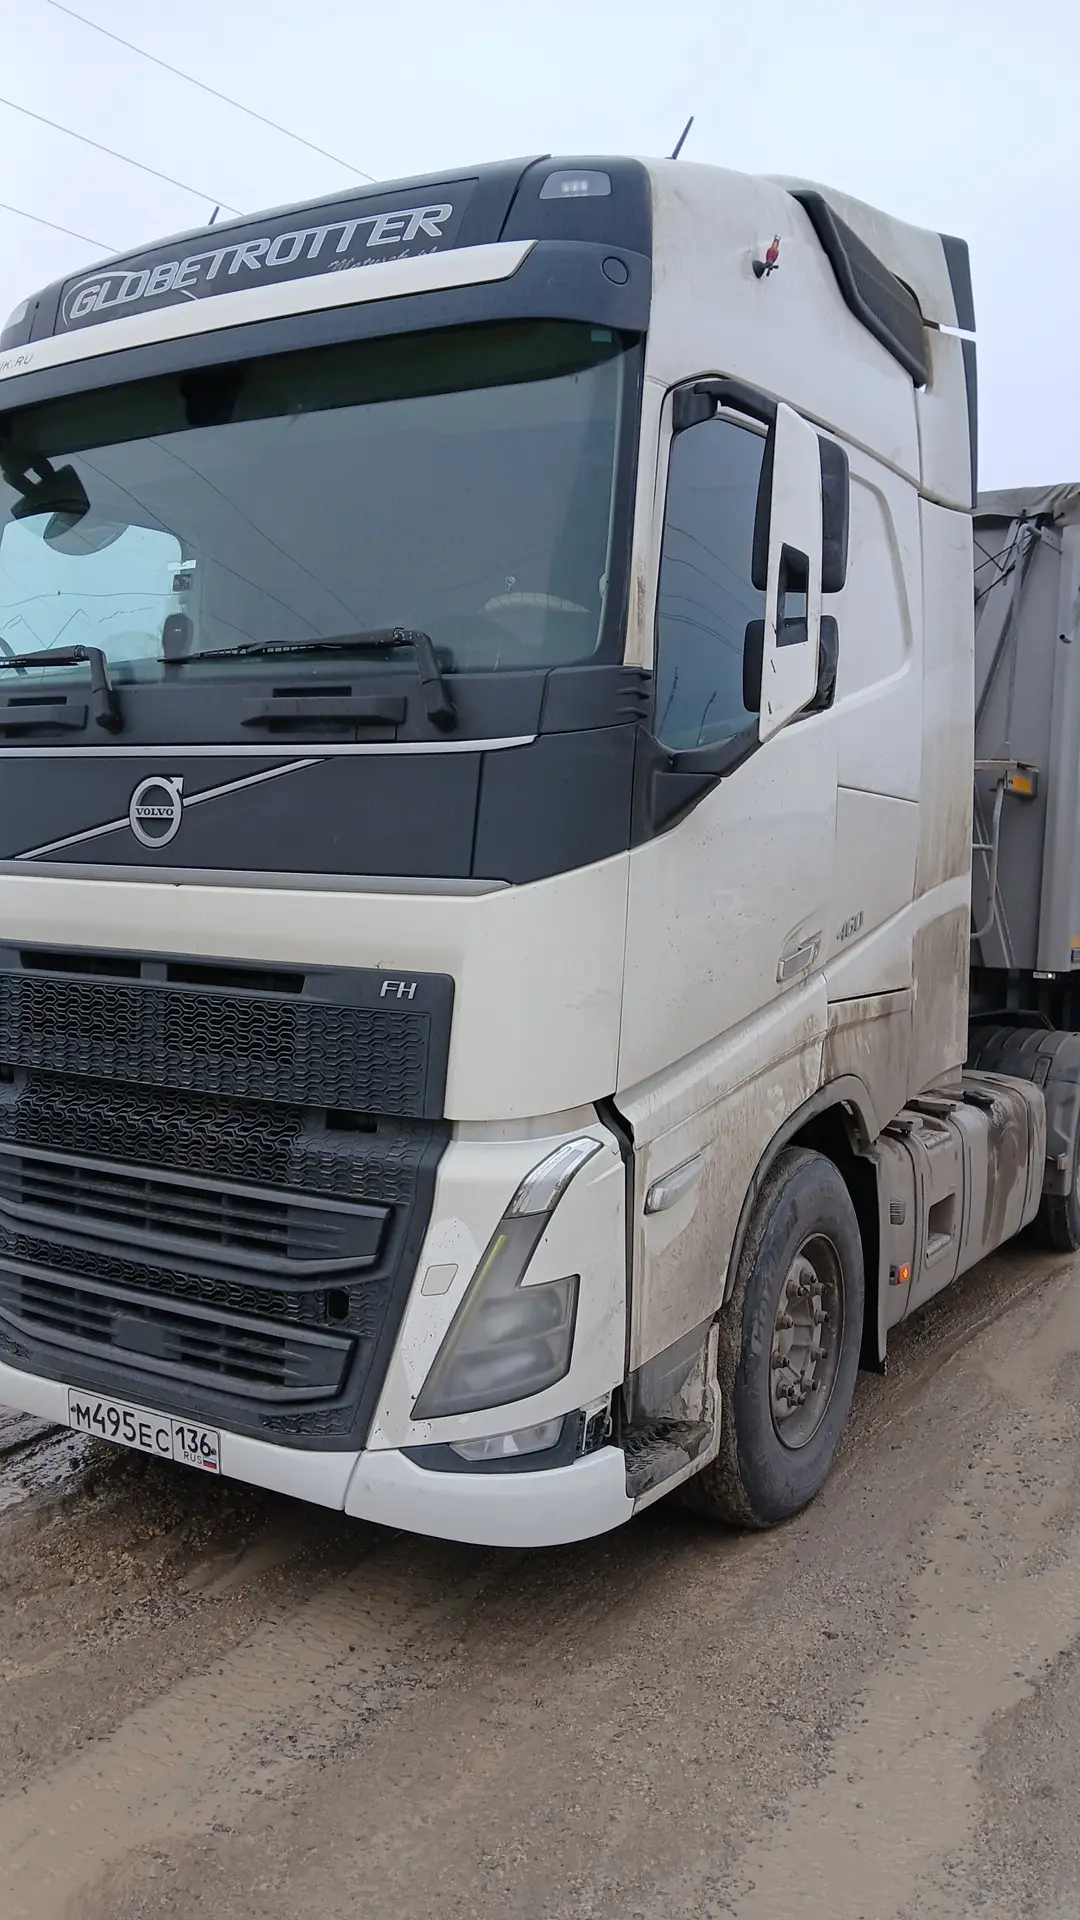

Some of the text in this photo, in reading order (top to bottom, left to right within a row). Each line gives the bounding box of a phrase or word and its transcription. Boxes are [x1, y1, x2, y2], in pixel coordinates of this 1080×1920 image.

[69, 204, 453, 319] GLOBETROTTER
[135, 807, 174, 816] VOLVO
[835, 910, 864, 941] 460
[379, 980, 418, 1000] FH
[76, 1403, 211, 1457] M495EC 136
[183, 1451, 202, 1464] RUS
